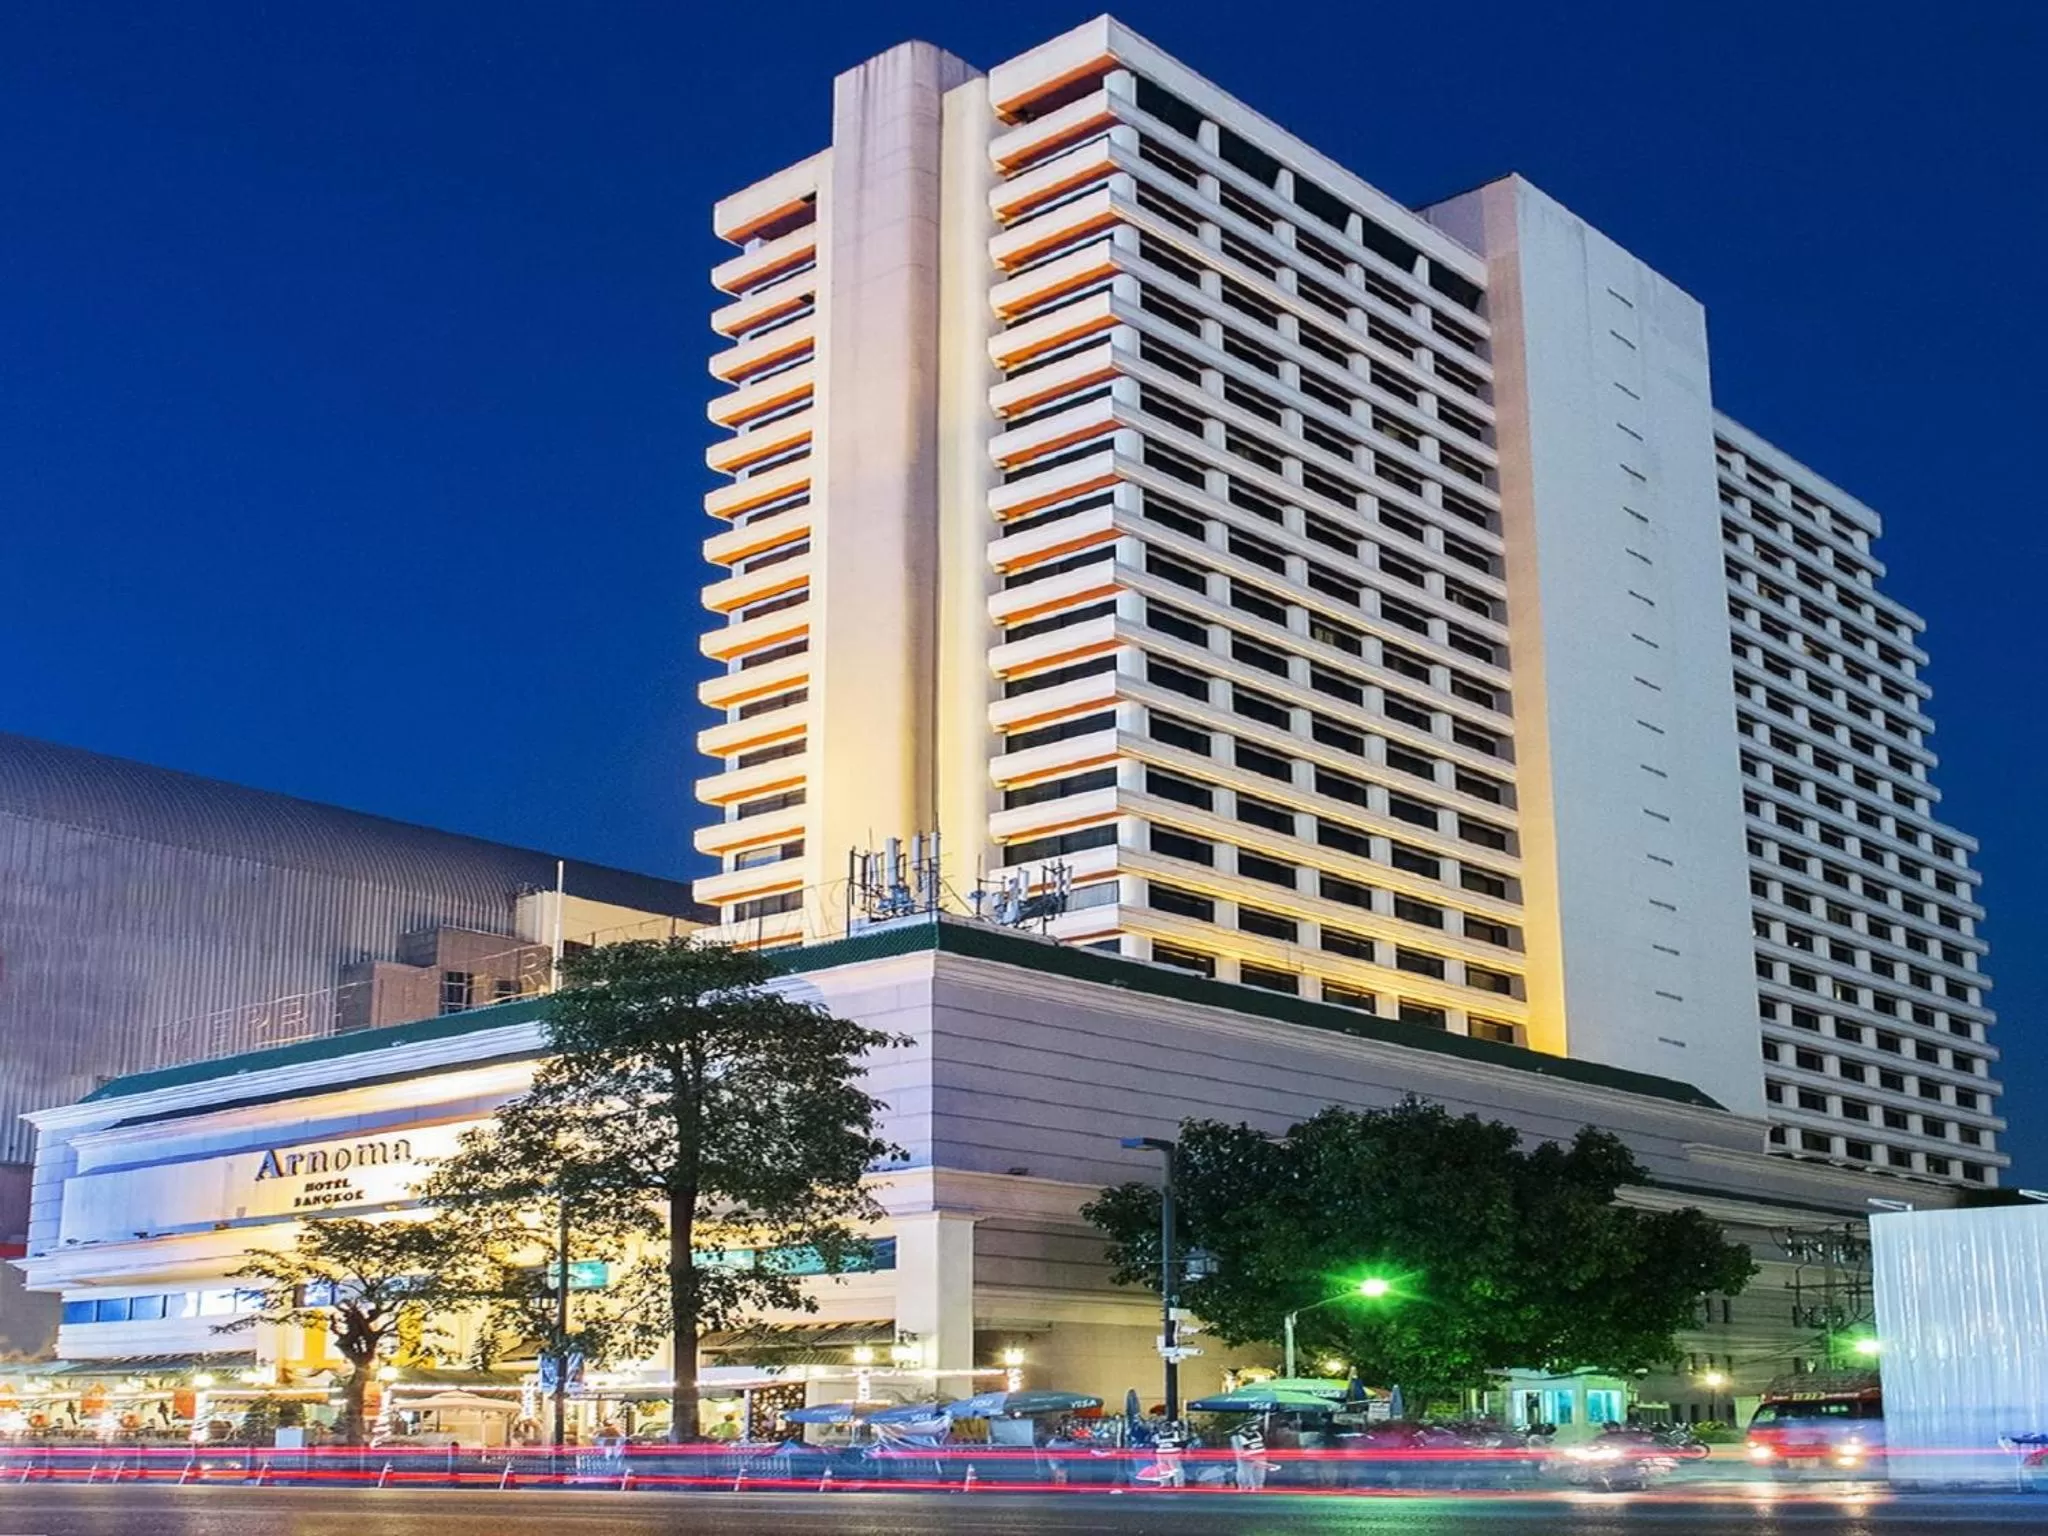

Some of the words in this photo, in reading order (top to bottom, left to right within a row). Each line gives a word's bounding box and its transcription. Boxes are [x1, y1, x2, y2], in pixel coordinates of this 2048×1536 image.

[255, 1139, 412, 1181] Arnoma
[304, 1178, 352, 1193] HOTEL
[294, 1189, 365, 1207] BANGKOK
